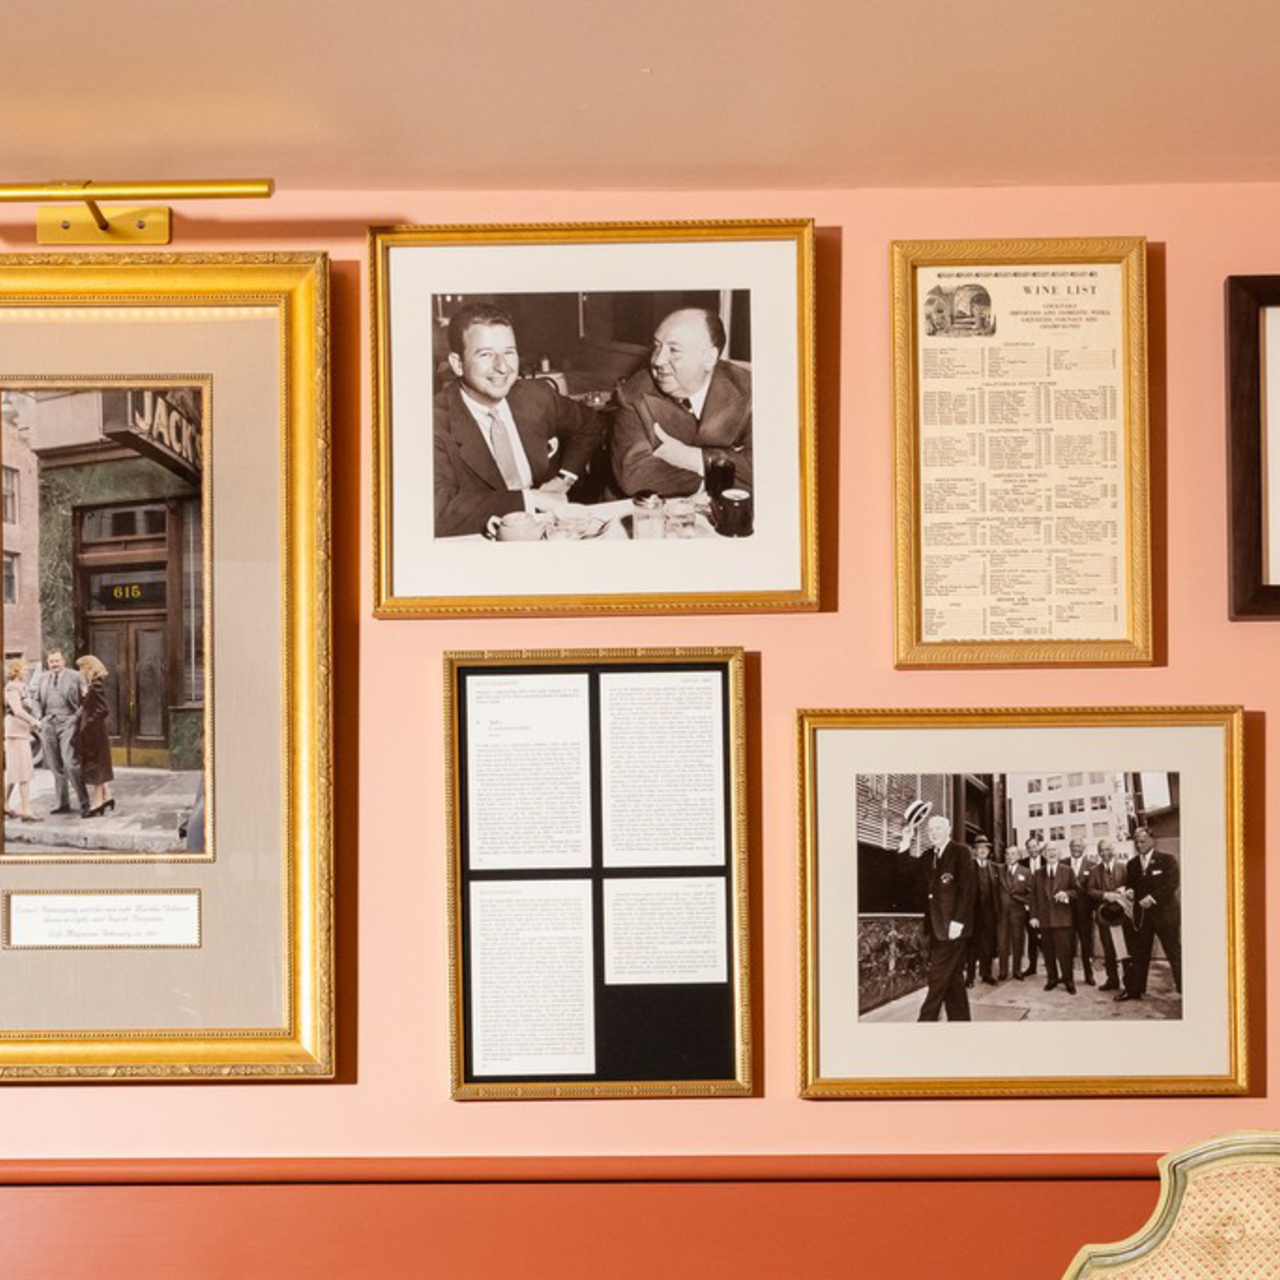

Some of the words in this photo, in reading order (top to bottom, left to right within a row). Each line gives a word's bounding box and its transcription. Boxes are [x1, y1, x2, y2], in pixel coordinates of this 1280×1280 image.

[1023, 286, 1061, 295] WINE
[1066, 285, 1098, 295] LIST
[113, 584, 141, 599] 615
